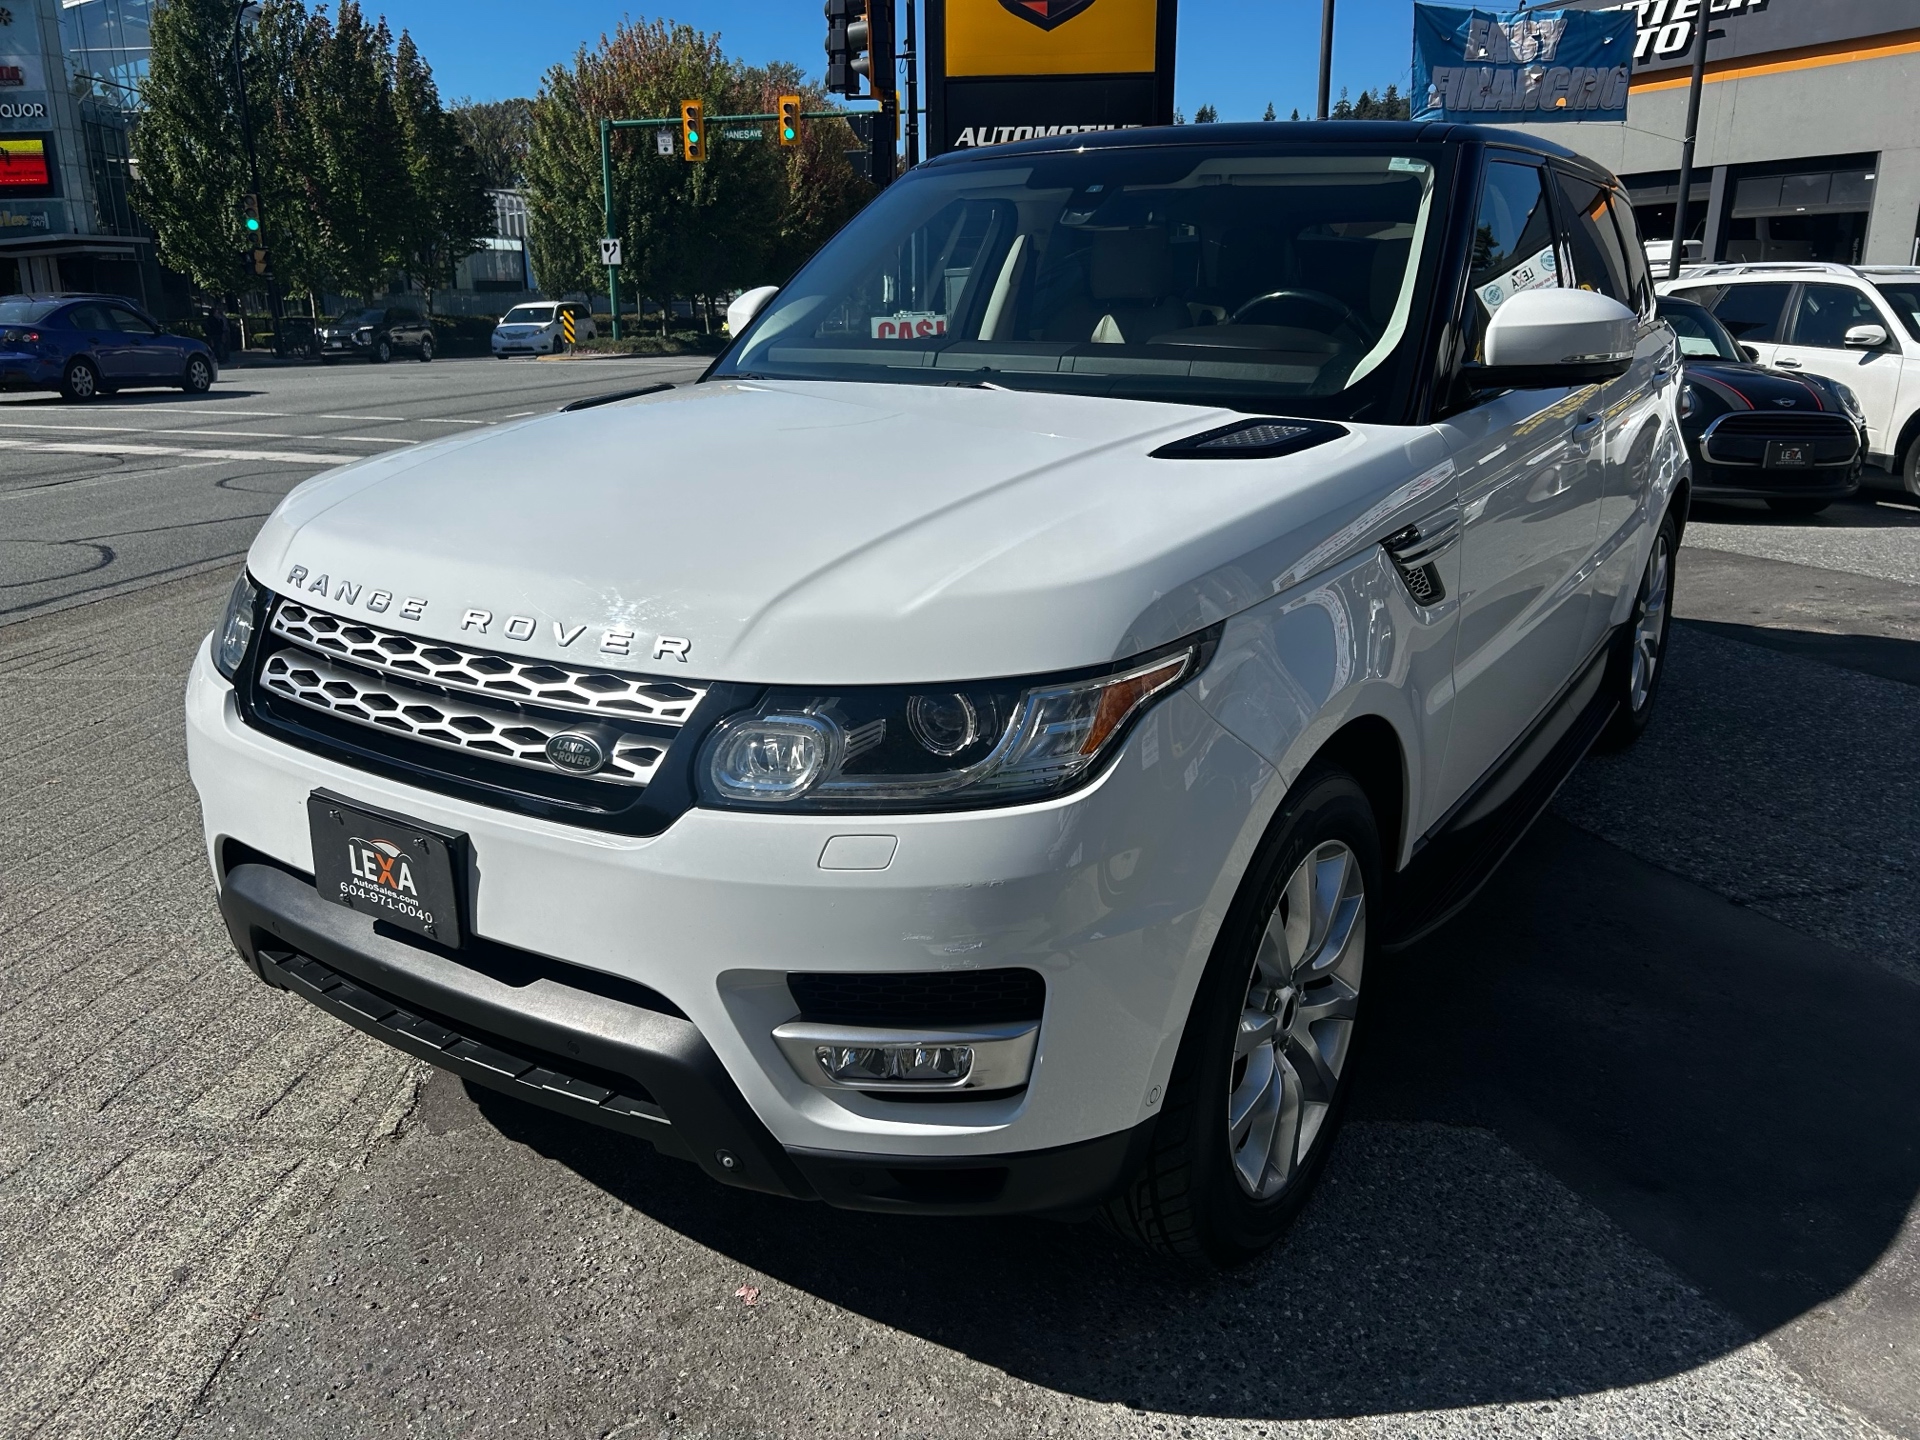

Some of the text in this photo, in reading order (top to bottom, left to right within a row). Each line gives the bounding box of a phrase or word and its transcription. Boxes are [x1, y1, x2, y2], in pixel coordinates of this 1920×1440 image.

[1464, 18, 1568, 64] EASY
[1633, 21, 1692, 58] TO
[1429, 66, 1630, 112] FINANCING
[0, 103, 45, 118] QUOR
[723, 129, 762, 139] HANES AVE
[1781, 450, 1802, 460] LEXA
[286, 564, 692, 663] RANGE ROVER
[556, 740, 585, 754] LAND
[557, 751, 592, 767] ROVER
[348, 844, 418, 896] LEXA
[340, 881, 433, 924] 604-971-0040
[352, 877, 419, 907] AutoSales.com
